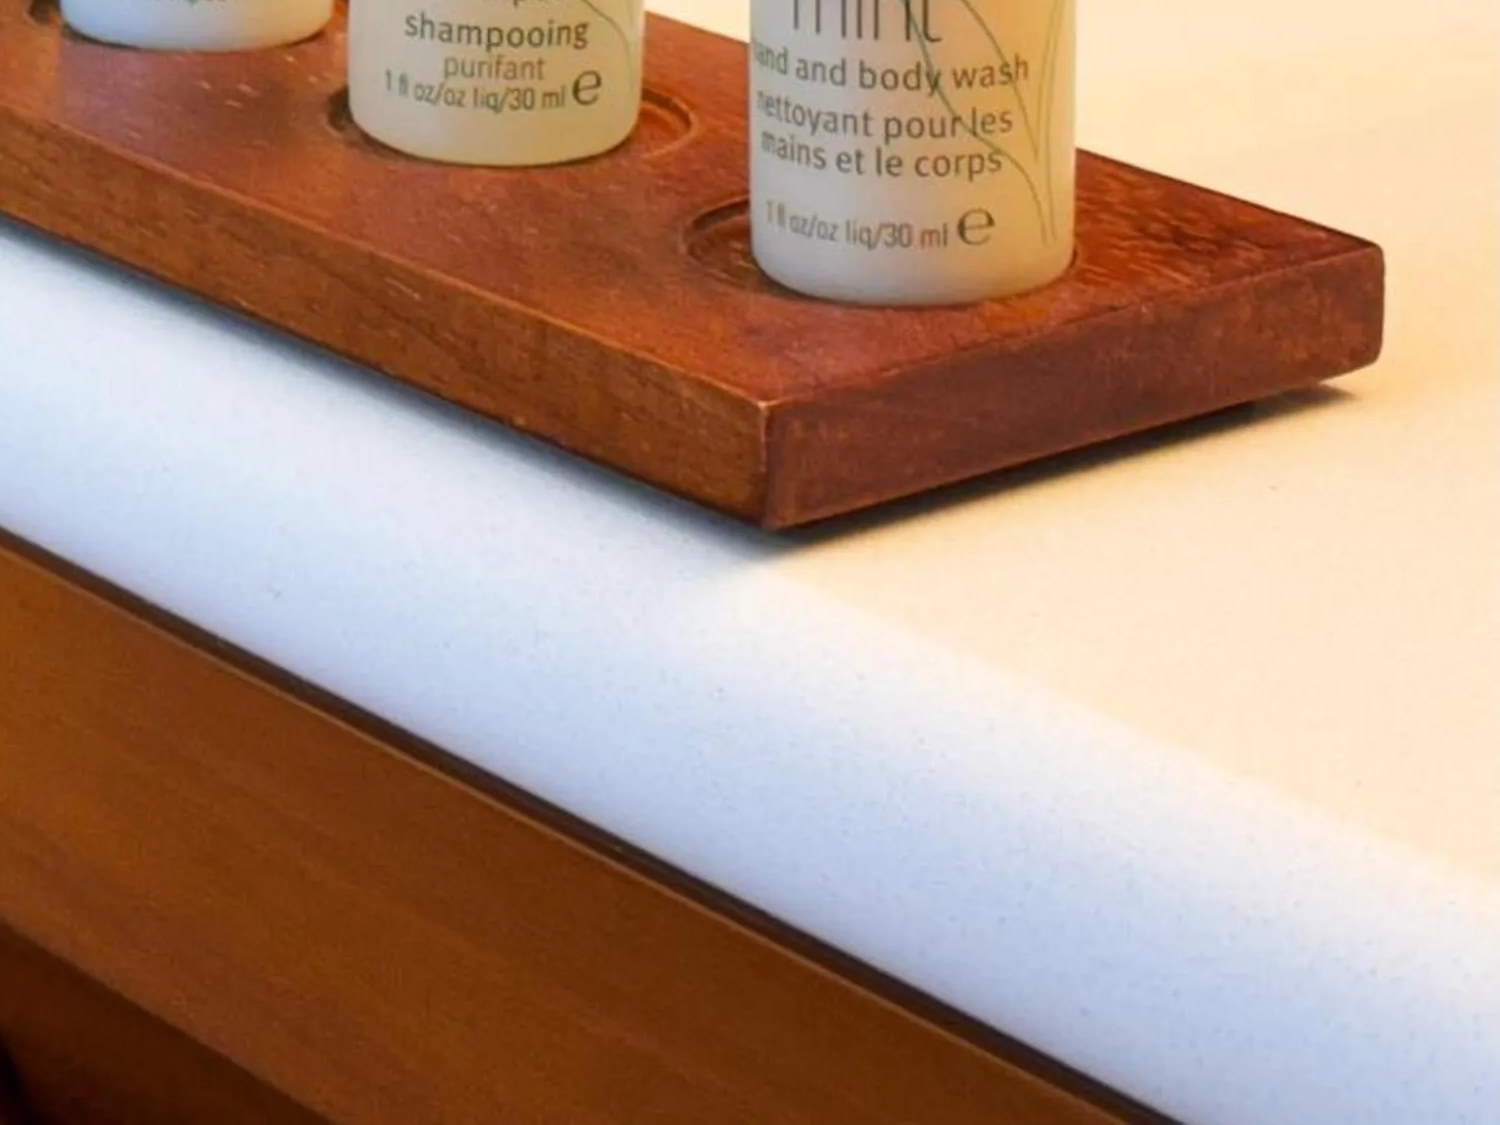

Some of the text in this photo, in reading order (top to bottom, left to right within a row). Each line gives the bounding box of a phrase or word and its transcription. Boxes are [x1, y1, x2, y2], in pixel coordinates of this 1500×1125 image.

[404, 12, 590, 53] shampooing
[443, 54, 546, 81] purifant
[795, 58, 847, 88] and
[858, 59, 941, 97] body
[951, 52, 1029, 89] wash
[541, 84, 566, 108] ml
[884, 114, 963, 146] pour
[971, 106, 1014, 138] les
[835, 147, 866, 176] et
[876, 146, 903, 177] le
[914, 149, 1003, 182] corps
[845, 219, 913, 251] liq/30
[920, 223, 949, 249] ml
